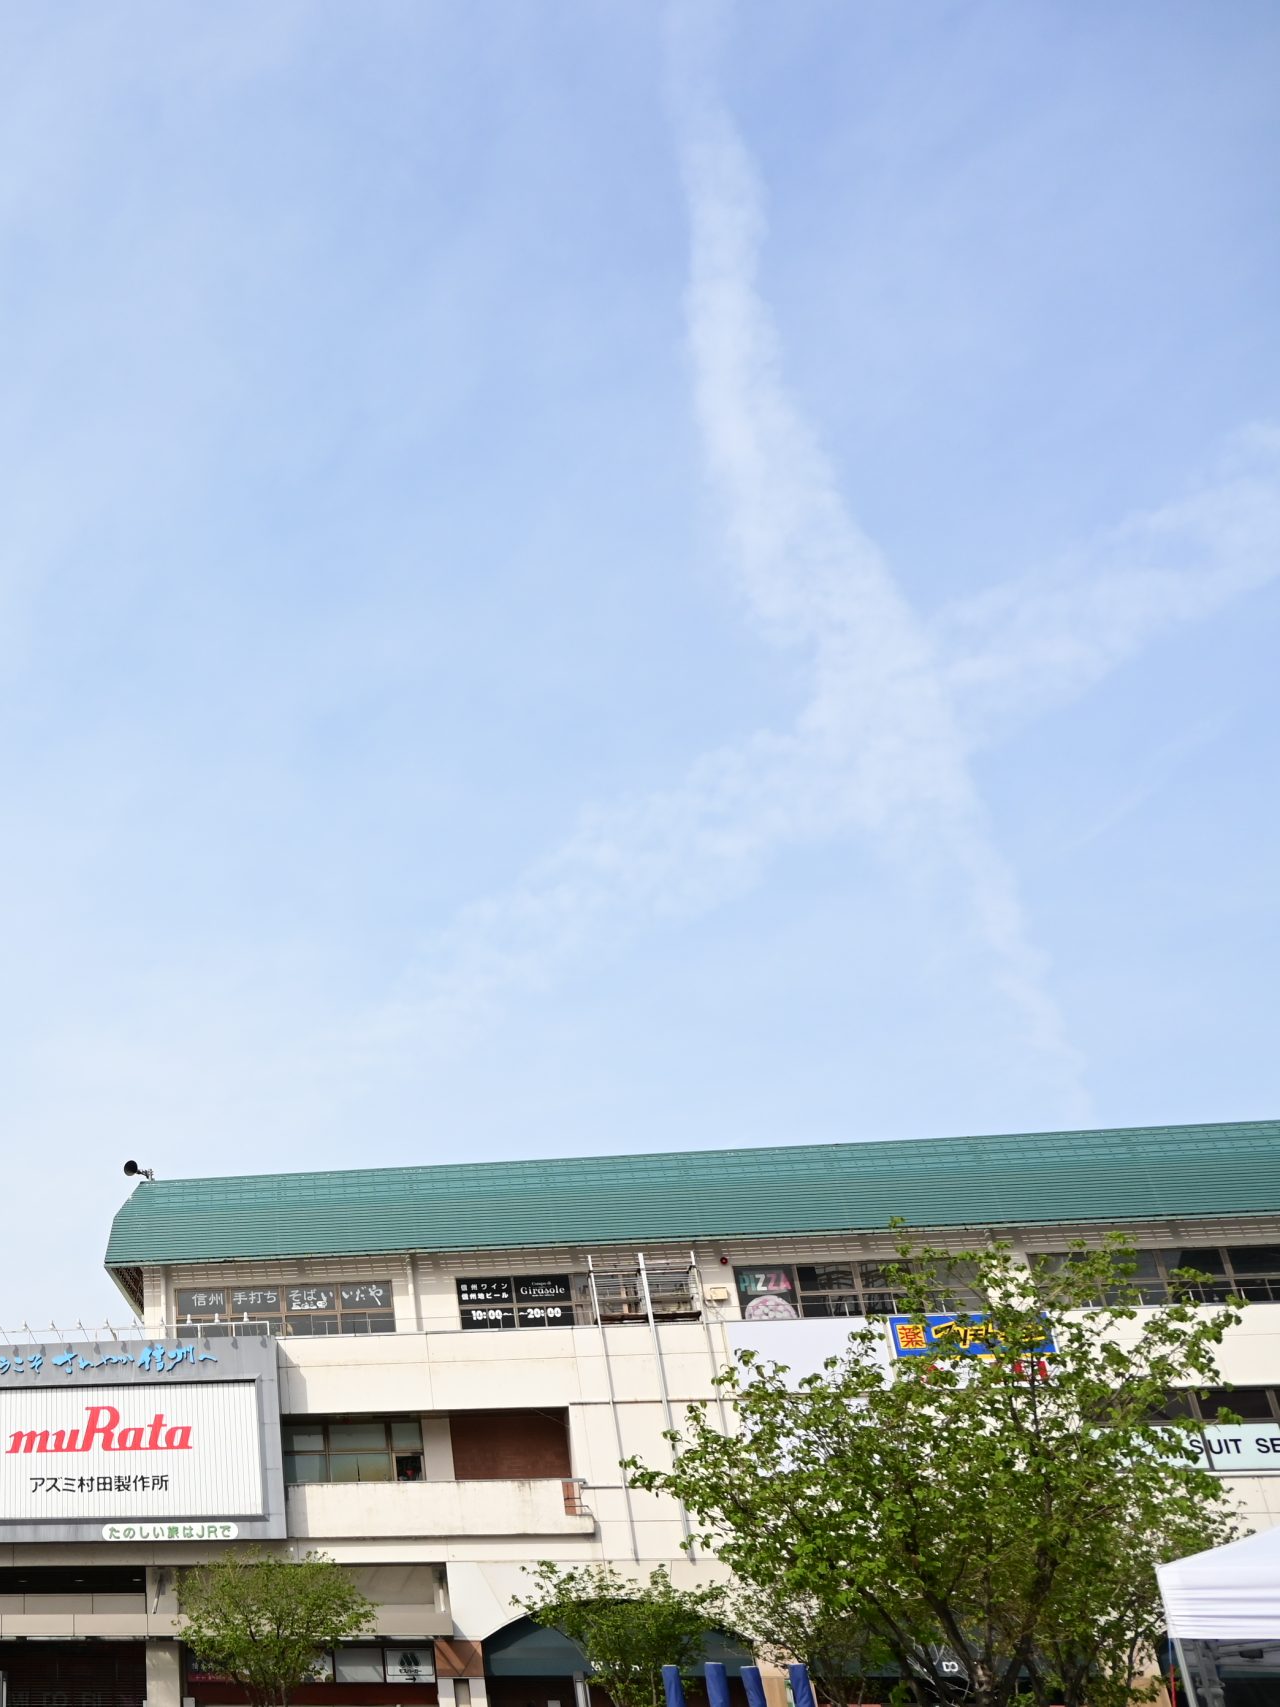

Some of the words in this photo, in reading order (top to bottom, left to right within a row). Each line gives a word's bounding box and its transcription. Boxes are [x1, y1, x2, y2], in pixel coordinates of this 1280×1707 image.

[460, 1283, 508, 1291] 信州ワイン
[738, 1270, 792, 1292] PIZZA
[192, 1292, 224, 1307] 信州
[233, 1290, 278, 1305] 手打ち
[288, 1288, 317, 1302] そば
[461, 1291, 509, 1300] 信州地ビール
[520, 1285, 566, 1295] Girasole
[5, 1405, 193, 1454] muRata
[1189, 1438, 1242, 1455] SUIT
[29, 1474, 169, 1493] アズミ村田製作所
[108, 1525, 232, 1539] たのしい旅はJRで
